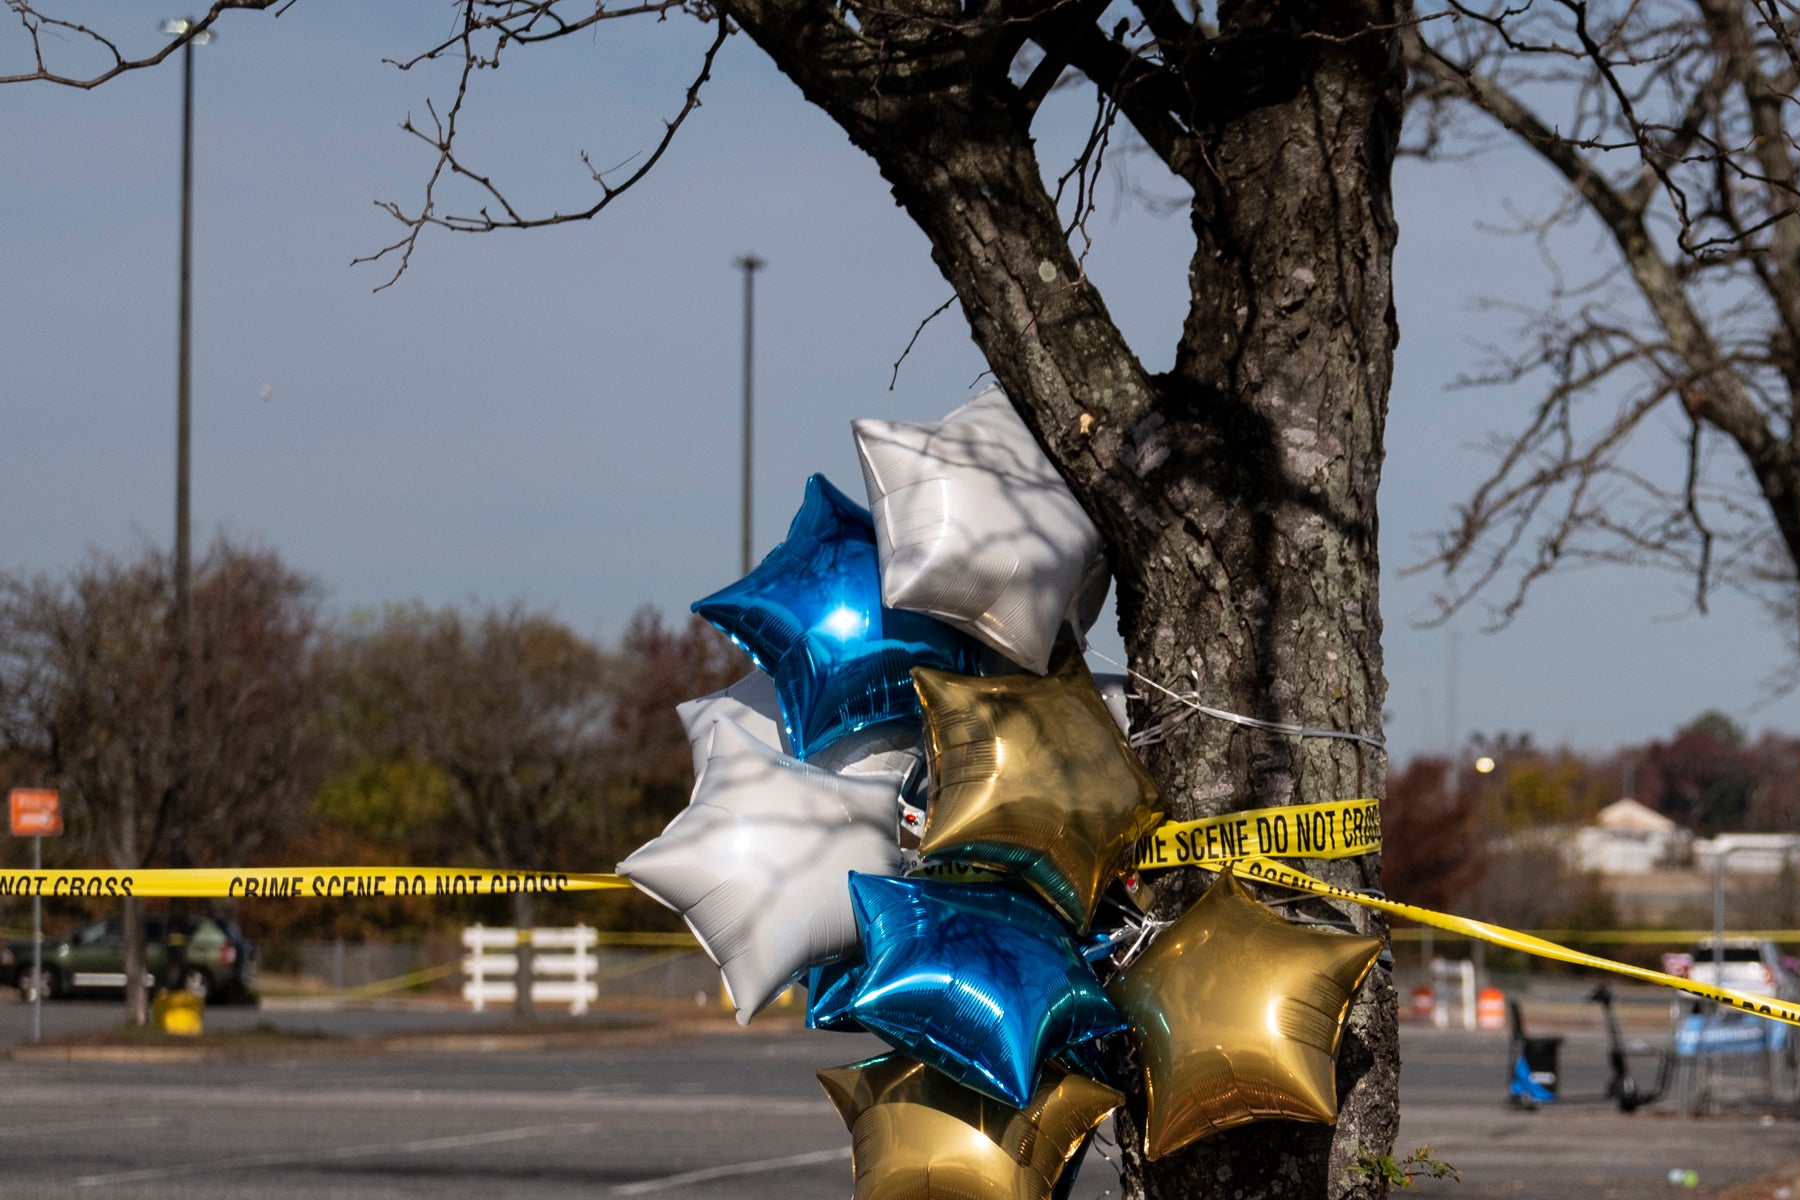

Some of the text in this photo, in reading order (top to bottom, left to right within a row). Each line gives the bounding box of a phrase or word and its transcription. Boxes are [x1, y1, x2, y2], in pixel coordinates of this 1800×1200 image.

[1175, 819, 1250, 862] SCENE
[1257, 815, 1289, 854] DO
[1296, 810, 1336, 852] NOT
